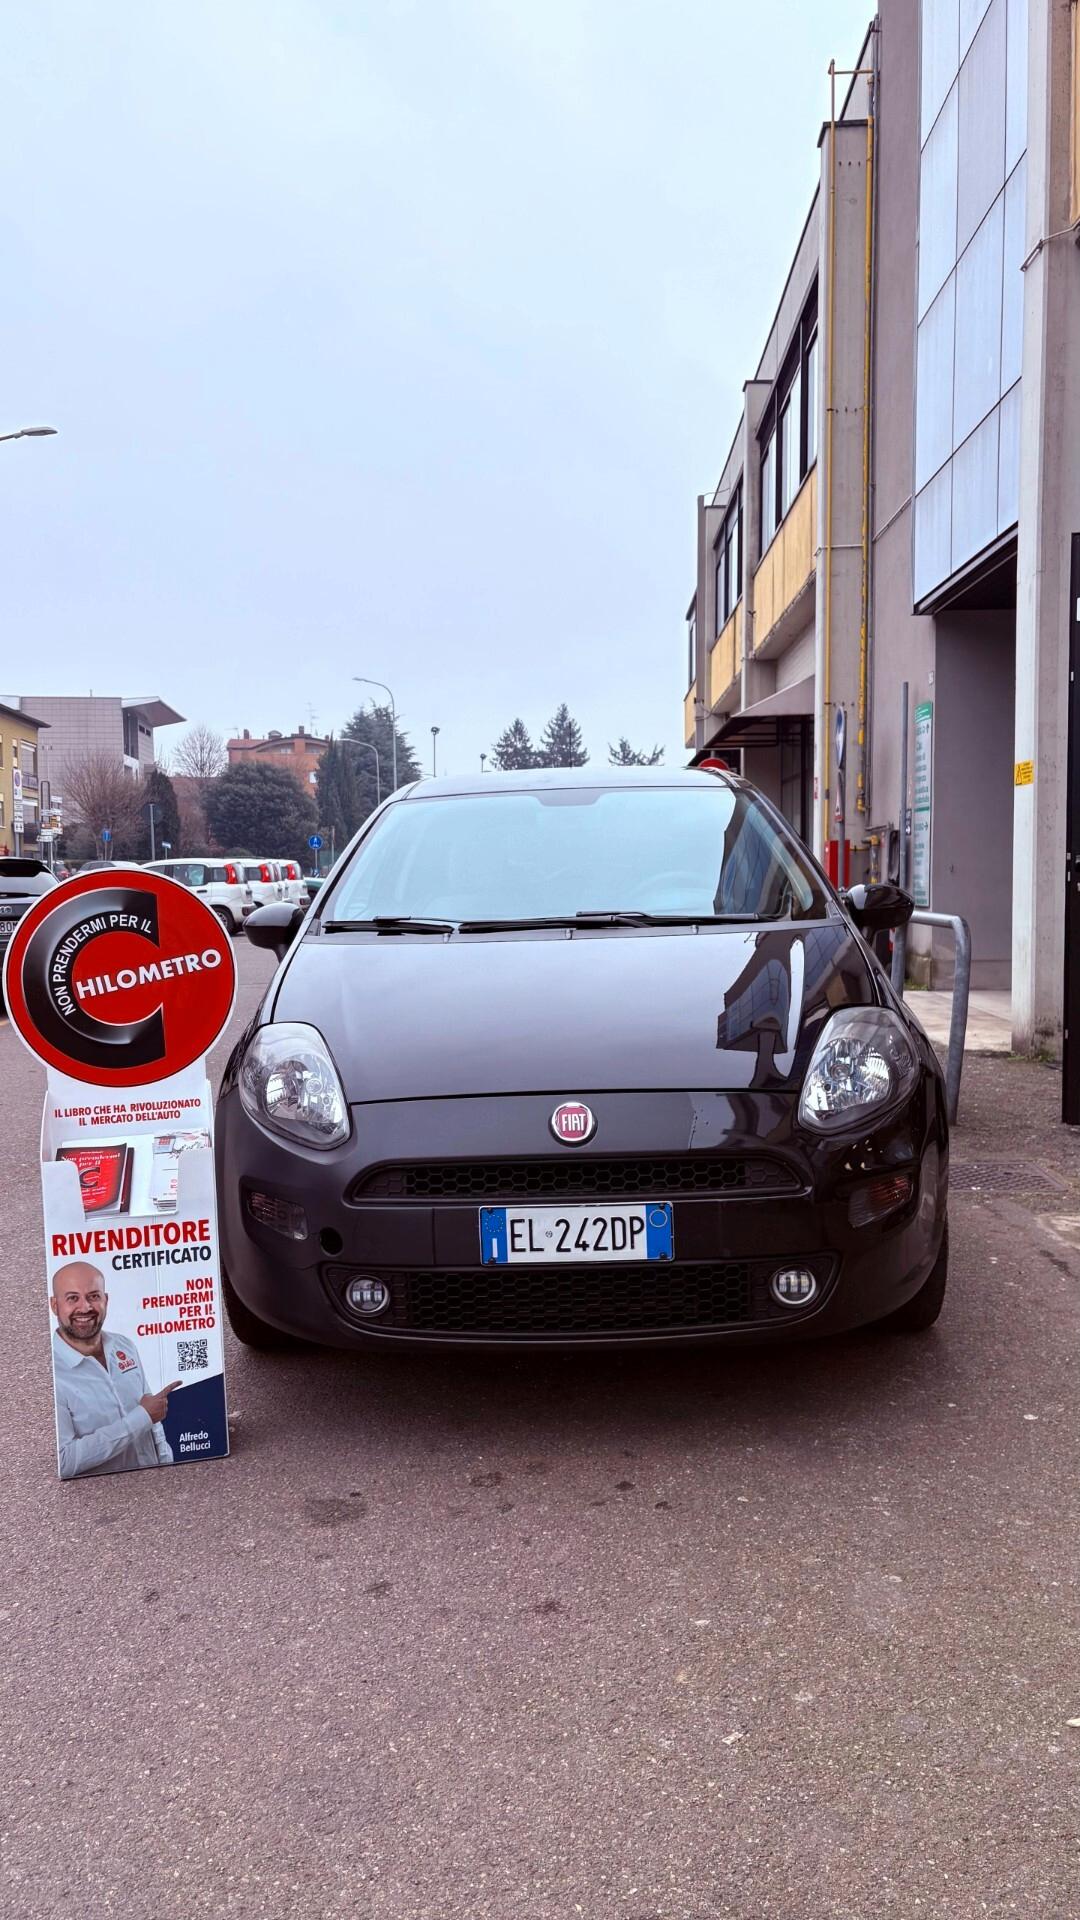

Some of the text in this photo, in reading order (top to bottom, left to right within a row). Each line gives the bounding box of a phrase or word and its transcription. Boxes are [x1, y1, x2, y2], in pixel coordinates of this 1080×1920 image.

[53, 914, 152, 1016] NON PRENDERMI PER IL
[76, 949, 221, 999] HILOMETRO
[55, 1098, 201, 1118] IL LIBRO CHE HA RIVOLUZIONATO
[79, 1110, 180, 1126] IL MERCATO DELL'AUTO
[562, 1113, 586, 1131] FIAT
[52, 1219, 211, 1256] RIVENDITORE
[510, 1219, 545, 1252] EL
[555, 1215, 645, 1252] 242DP
[112, 1246, 212, 1271] CERTIFICATO
[186, 1277, 213, 1291] NON
[142, 1291, 213, 1309] PRENDERMI
[179, 1305, 201, 1318] PER
[137, 1317, 215, 1336] CHILOMETRO
[180, 1431, 209, 1442] Alfredo
[180, 1440, 211, 1453] Bellucci
